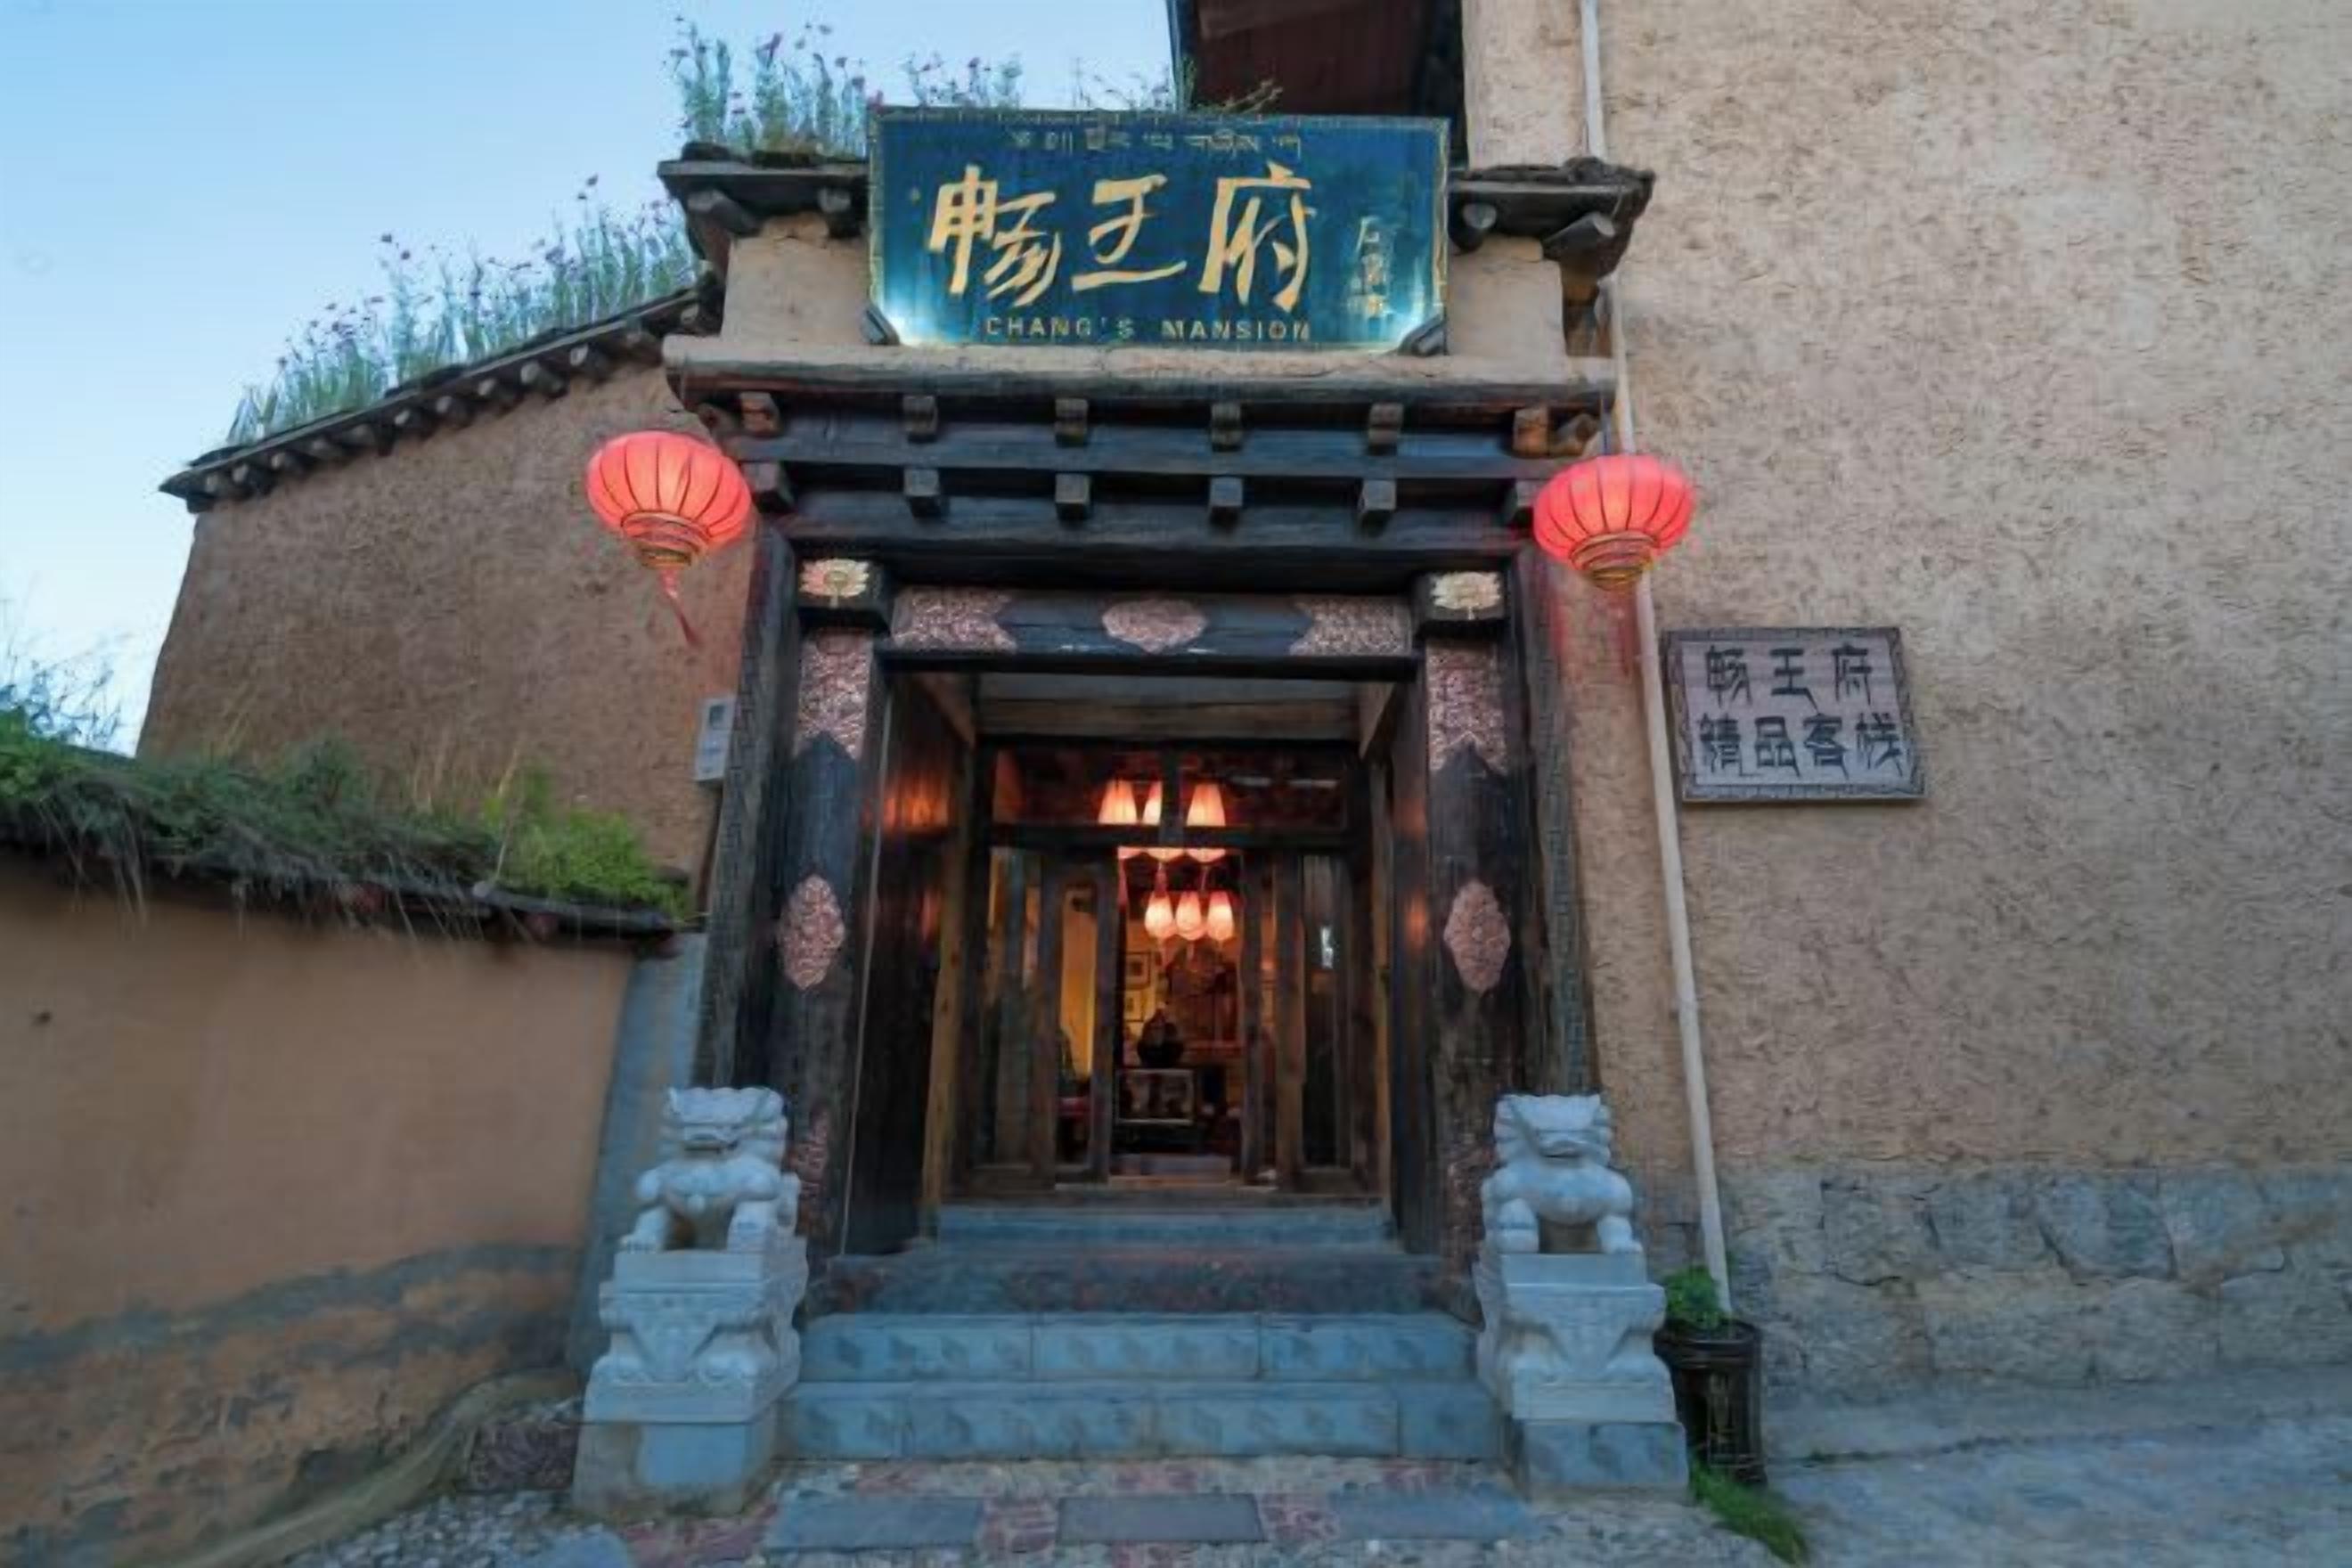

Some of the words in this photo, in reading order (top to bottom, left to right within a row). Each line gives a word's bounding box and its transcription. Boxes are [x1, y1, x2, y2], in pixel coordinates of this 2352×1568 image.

[928, 159, 1317, 313] 畅王府
[985, 316, 1135, 339] CHANG'S
[1161, 319, 1311, 340] MANSION
[1704, 641, 1874, 710] 畅王府
[1698, 713, 1904, 779] 精品客栈
